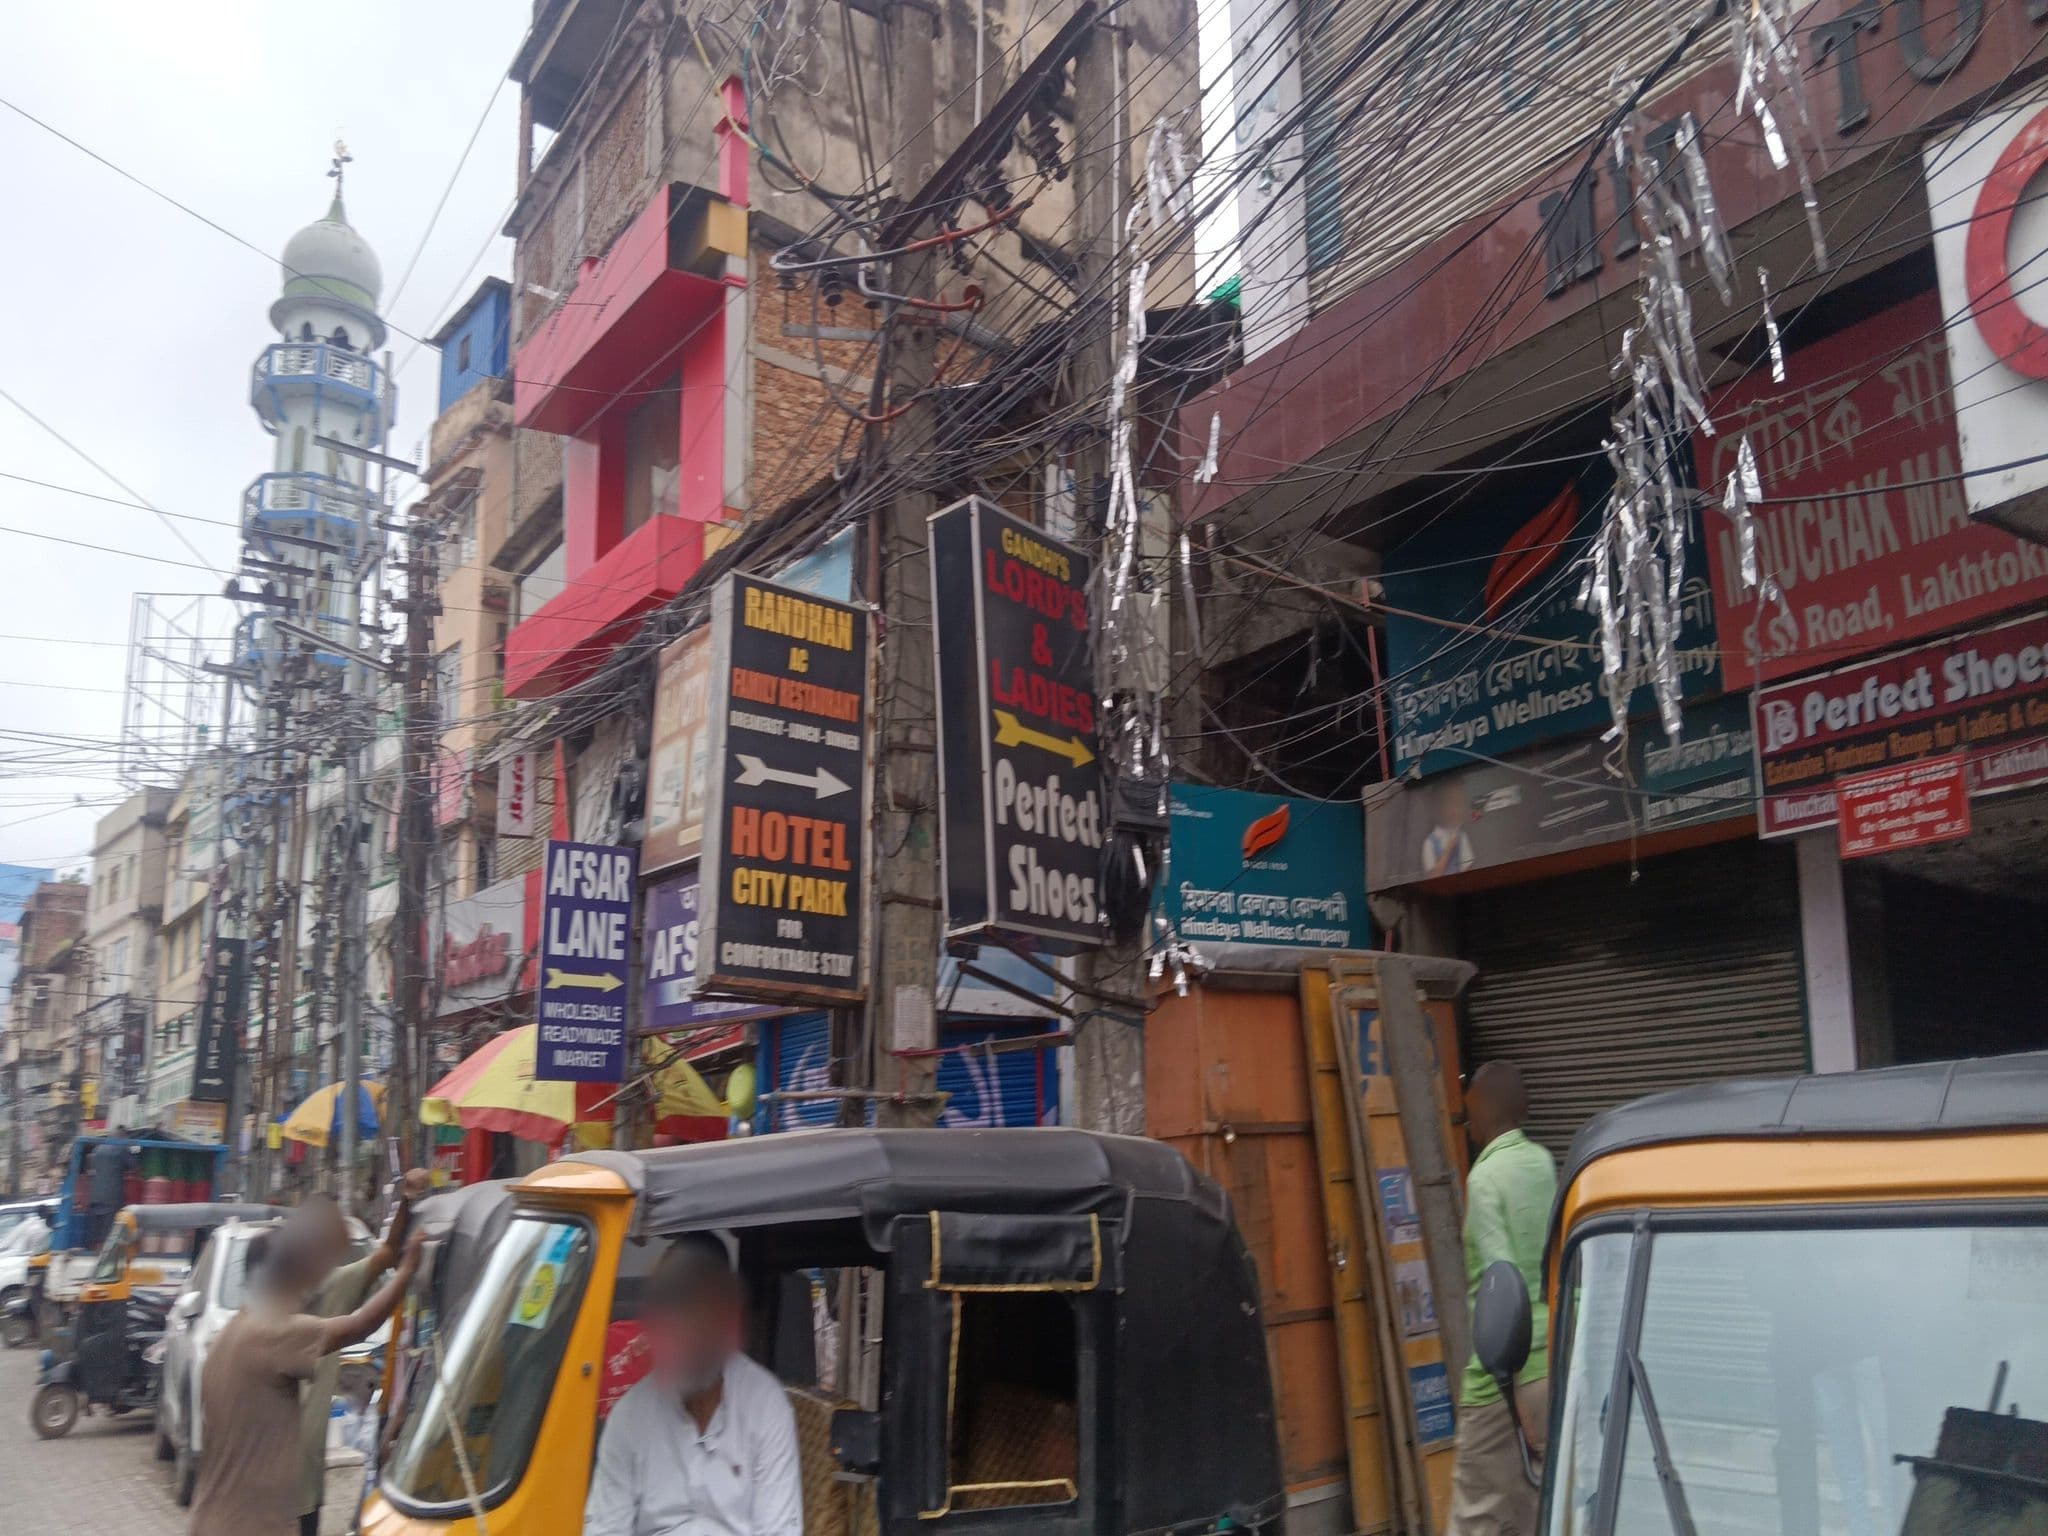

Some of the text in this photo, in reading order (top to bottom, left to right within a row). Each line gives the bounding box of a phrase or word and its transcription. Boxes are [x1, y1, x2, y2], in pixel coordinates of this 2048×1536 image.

[1901, 445, 1970, 545] MA
[986, 548, 1088, 631] LORD'S
[1805, 583, 1895, 649] Road,
[1901, 538, 2048, 618] Lakhtok
[1031, 623, 1054, 666] &
[992, 658, 1095, 733] LADIES
[1395, 715, 1490, 761] Himalaya
[1492, 682, 1593, 730] Wellness
[1802, 667, 1934, 738] Perfect
[995, 758, 1101, 849] Perfect
[731, 805, 852, 871] HOTEL
[549, 848, 630, 903] AFSAR
[732, 867, 787, 908] CITY
[787, 874, 848, 916] PARK
[1008, 844, 1096, 924] Shoes
[549, 907, 627, 961] LANE
[650, 919, 698, 979] AFS
[777, 919, 803, 939] FOR
[1241, 919, 1295, 942] Wellness
[1295, 923, 1350, 948] Company
[820, 952, 855, 977] STAY
[541, 1026, 622, 1045] READYMADE
[543, 1002, 623, 1022] WHOLESALE
[553, 1050, 608, 1068] MARKET
